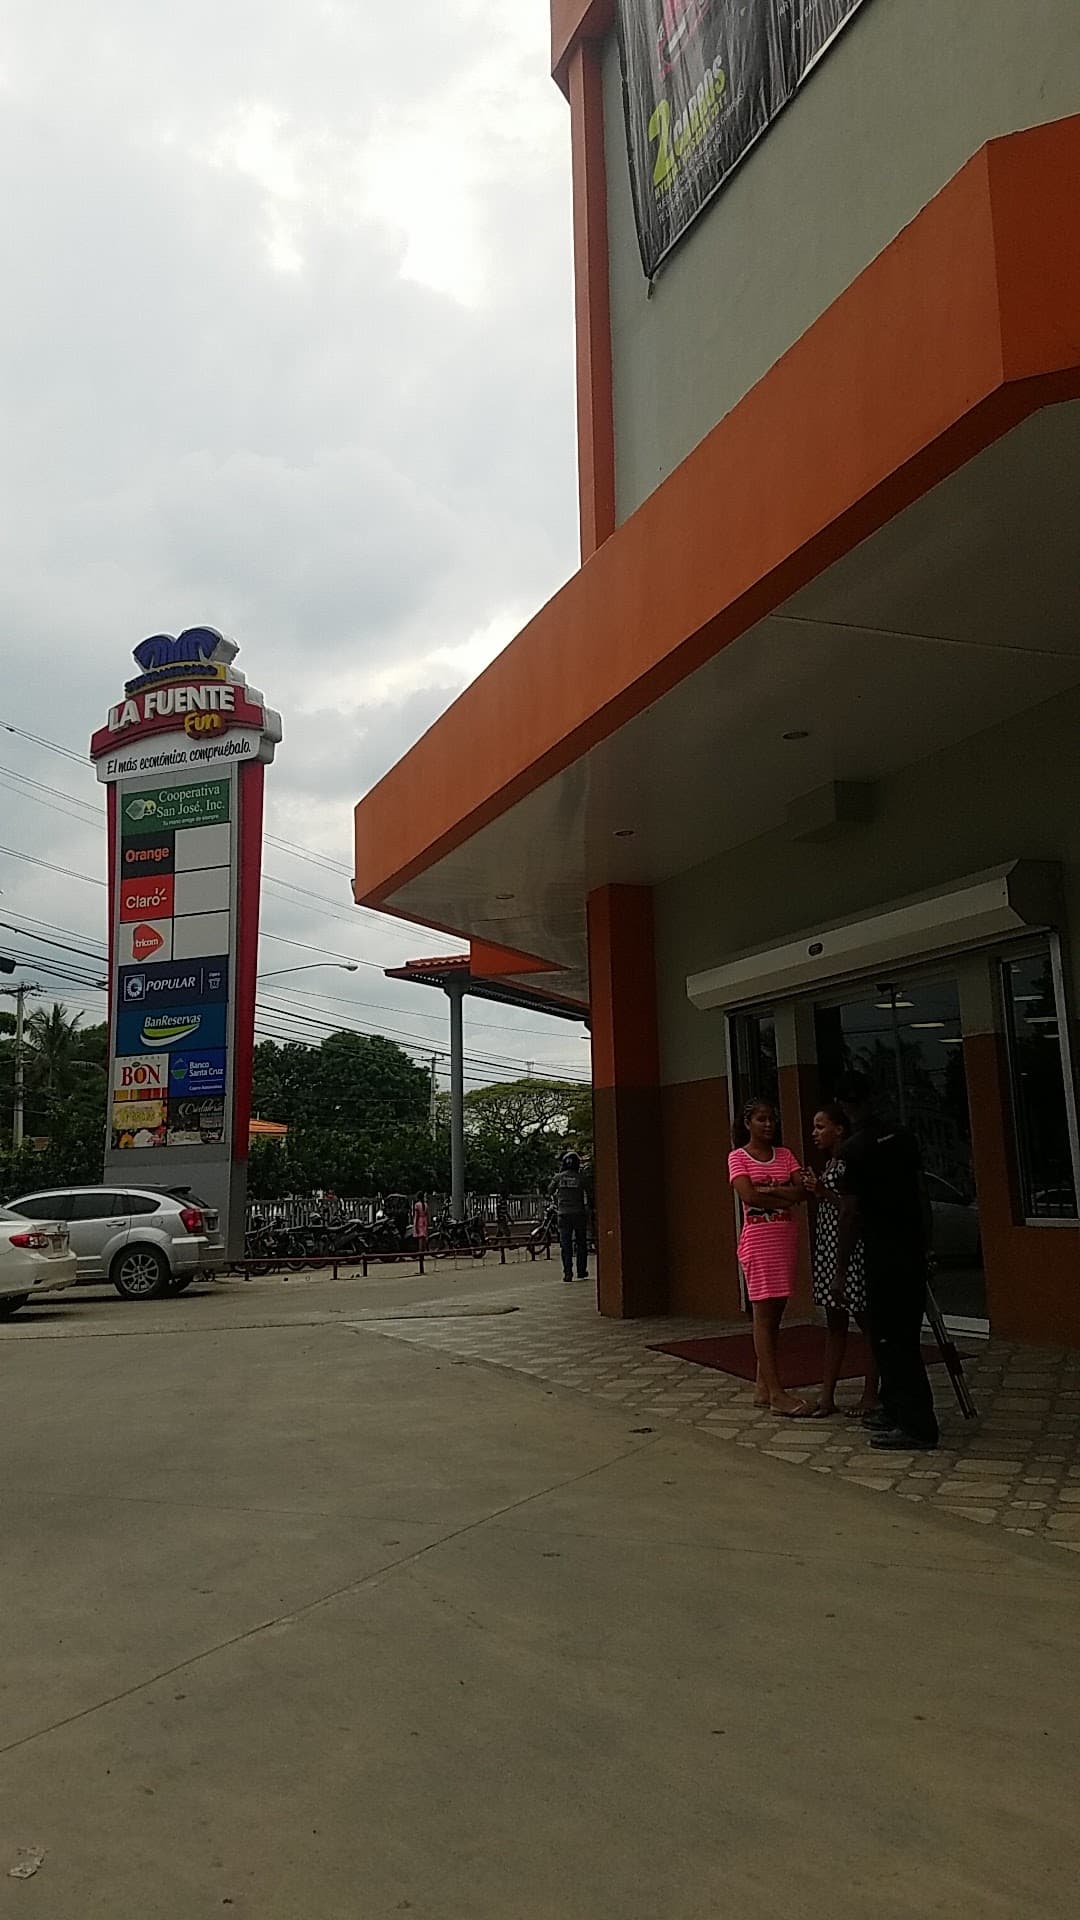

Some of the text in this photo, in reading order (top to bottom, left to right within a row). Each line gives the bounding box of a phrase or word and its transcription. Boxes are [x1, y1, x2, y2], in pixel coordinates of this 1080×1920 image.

[648, 99, 670, 186] 2
[672, 54, 725, 156] CARROS
[108, 685, 235, 732] LA FUENTE
[184, 711, 219, 733] Fun
[107, 759, 117, 775] El
[118, 757, 138, 773] más
[158, 784, 220, 803] Cooperativa
[156, 805, 175, 818] San
[206, 799, 225, 811] Inc.
[125, 847, 170, 863] Orange
[126, 895, 160, 909] Claro
[135, 938, 159, 948] tricom
[146, 976, 196, 992] POPULAR
[144, 1014, 202, 1028] BanReservas
[189, 1061, 210, 1069] Banco
[189, 1067, 224, 1077] Santa Cruz
[121, 1063, 161, 1087] BON
